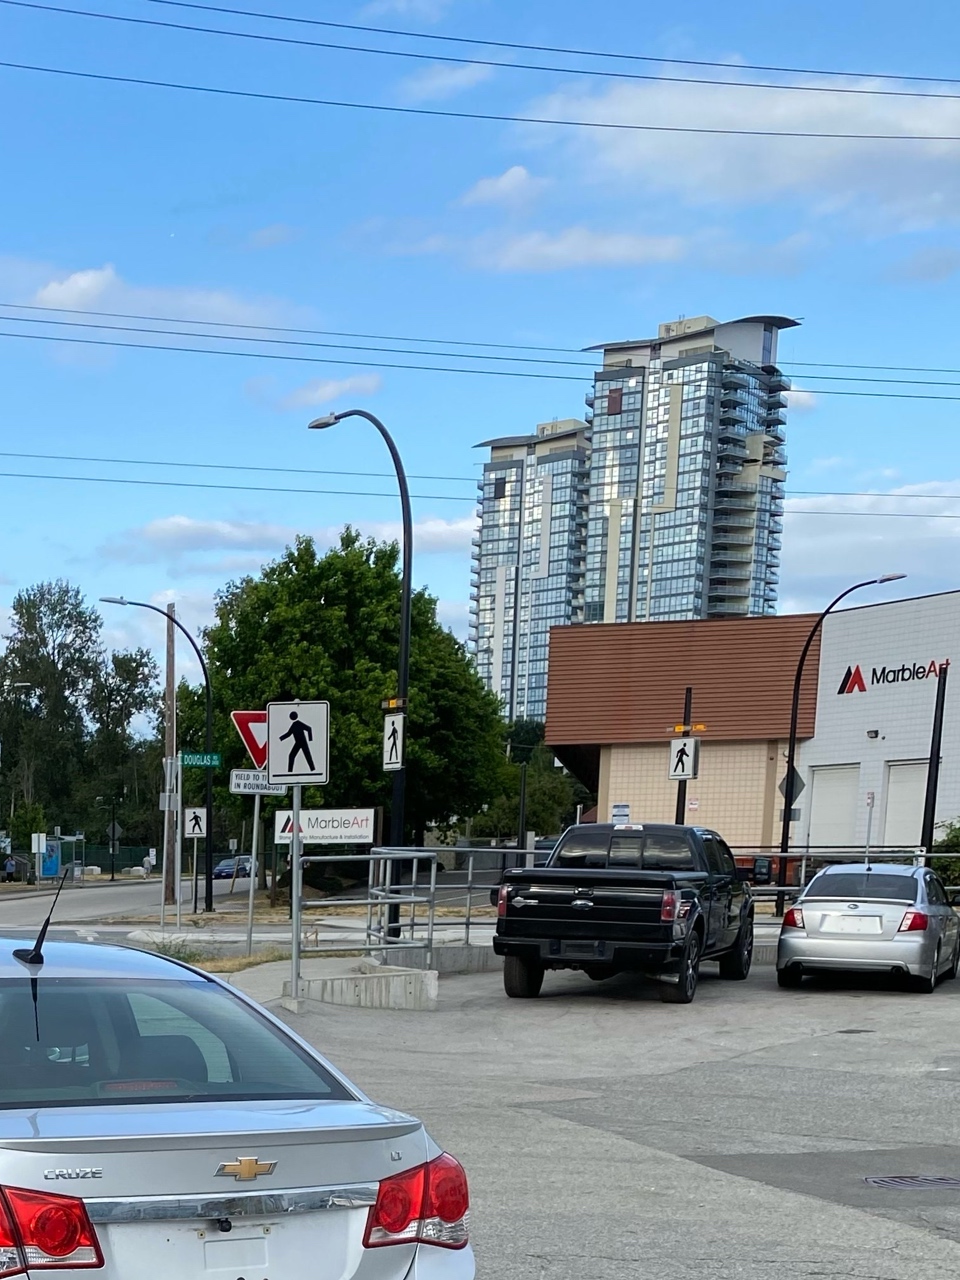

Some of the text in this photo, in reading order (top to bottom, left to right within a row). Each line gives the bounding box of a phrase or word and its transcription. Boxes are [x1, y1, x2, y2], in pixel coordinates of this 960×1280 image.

[183, 754, 211, 765] DOUGLAS
[235, 782, 241, 790] IN
[307, 815, 369, 829] MarbleArt
[43, 1167, 103, 1181] CRUZE
